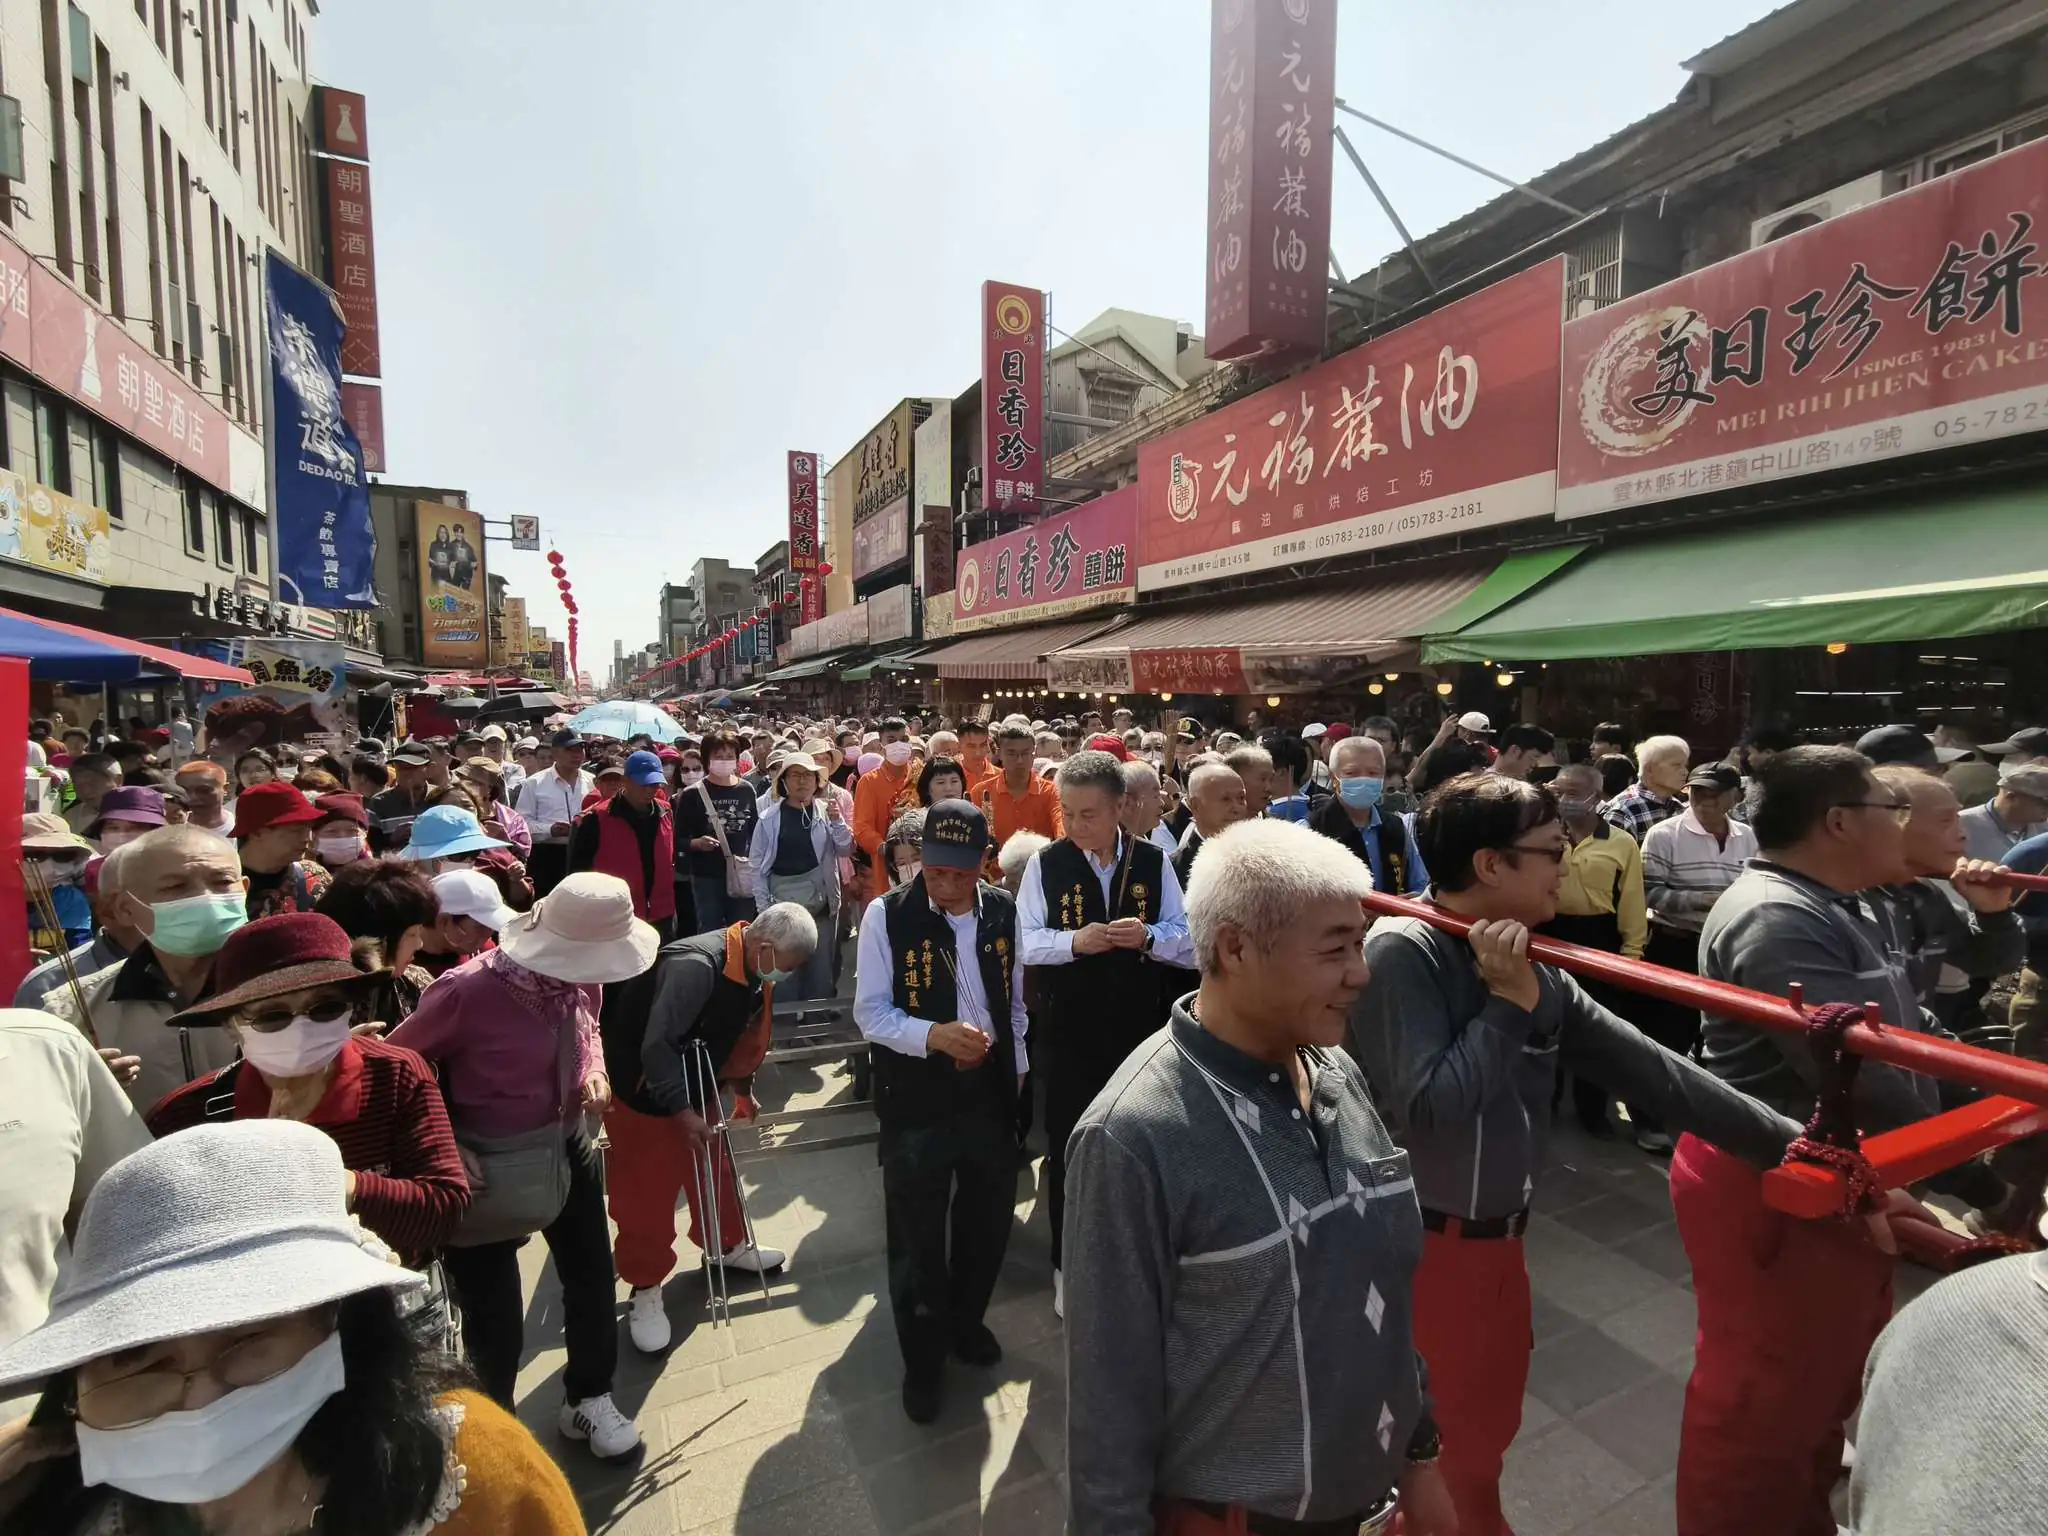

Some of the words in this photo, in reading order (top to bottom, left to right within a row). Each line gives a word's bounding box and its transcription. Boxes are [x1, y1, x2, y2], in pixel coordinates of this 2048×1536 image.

[337, 168, 367, 288] 朝聖酒店
[1632, 212, 2048, 421] 美日珍餅
[118, 353, 205, 458] 朝聖酒店
[996, 351, 1036, 471] 日香珍
[1717, 409, 1767, 435] MEI
[1778, 395, 1832, 421] RIH
[1843, 368, 1929, 410] JHEN
[299, 460, 342, 481] DEDAO
[1328, 469, 1433, 511] 烘焙工坊
[1613, 425, 1904, 503] 雲林縣北港鎮中山路149號
[319, 511, 339, 589] 茶飲專賣店
[995, 521, 1081, 600] 日香珍
[1083, 543, 1127, 589] 囍餅
[1315, 521, 1384, 549] (05)783-2180
[1398, 502, 1483, 532] (05)783-2181
